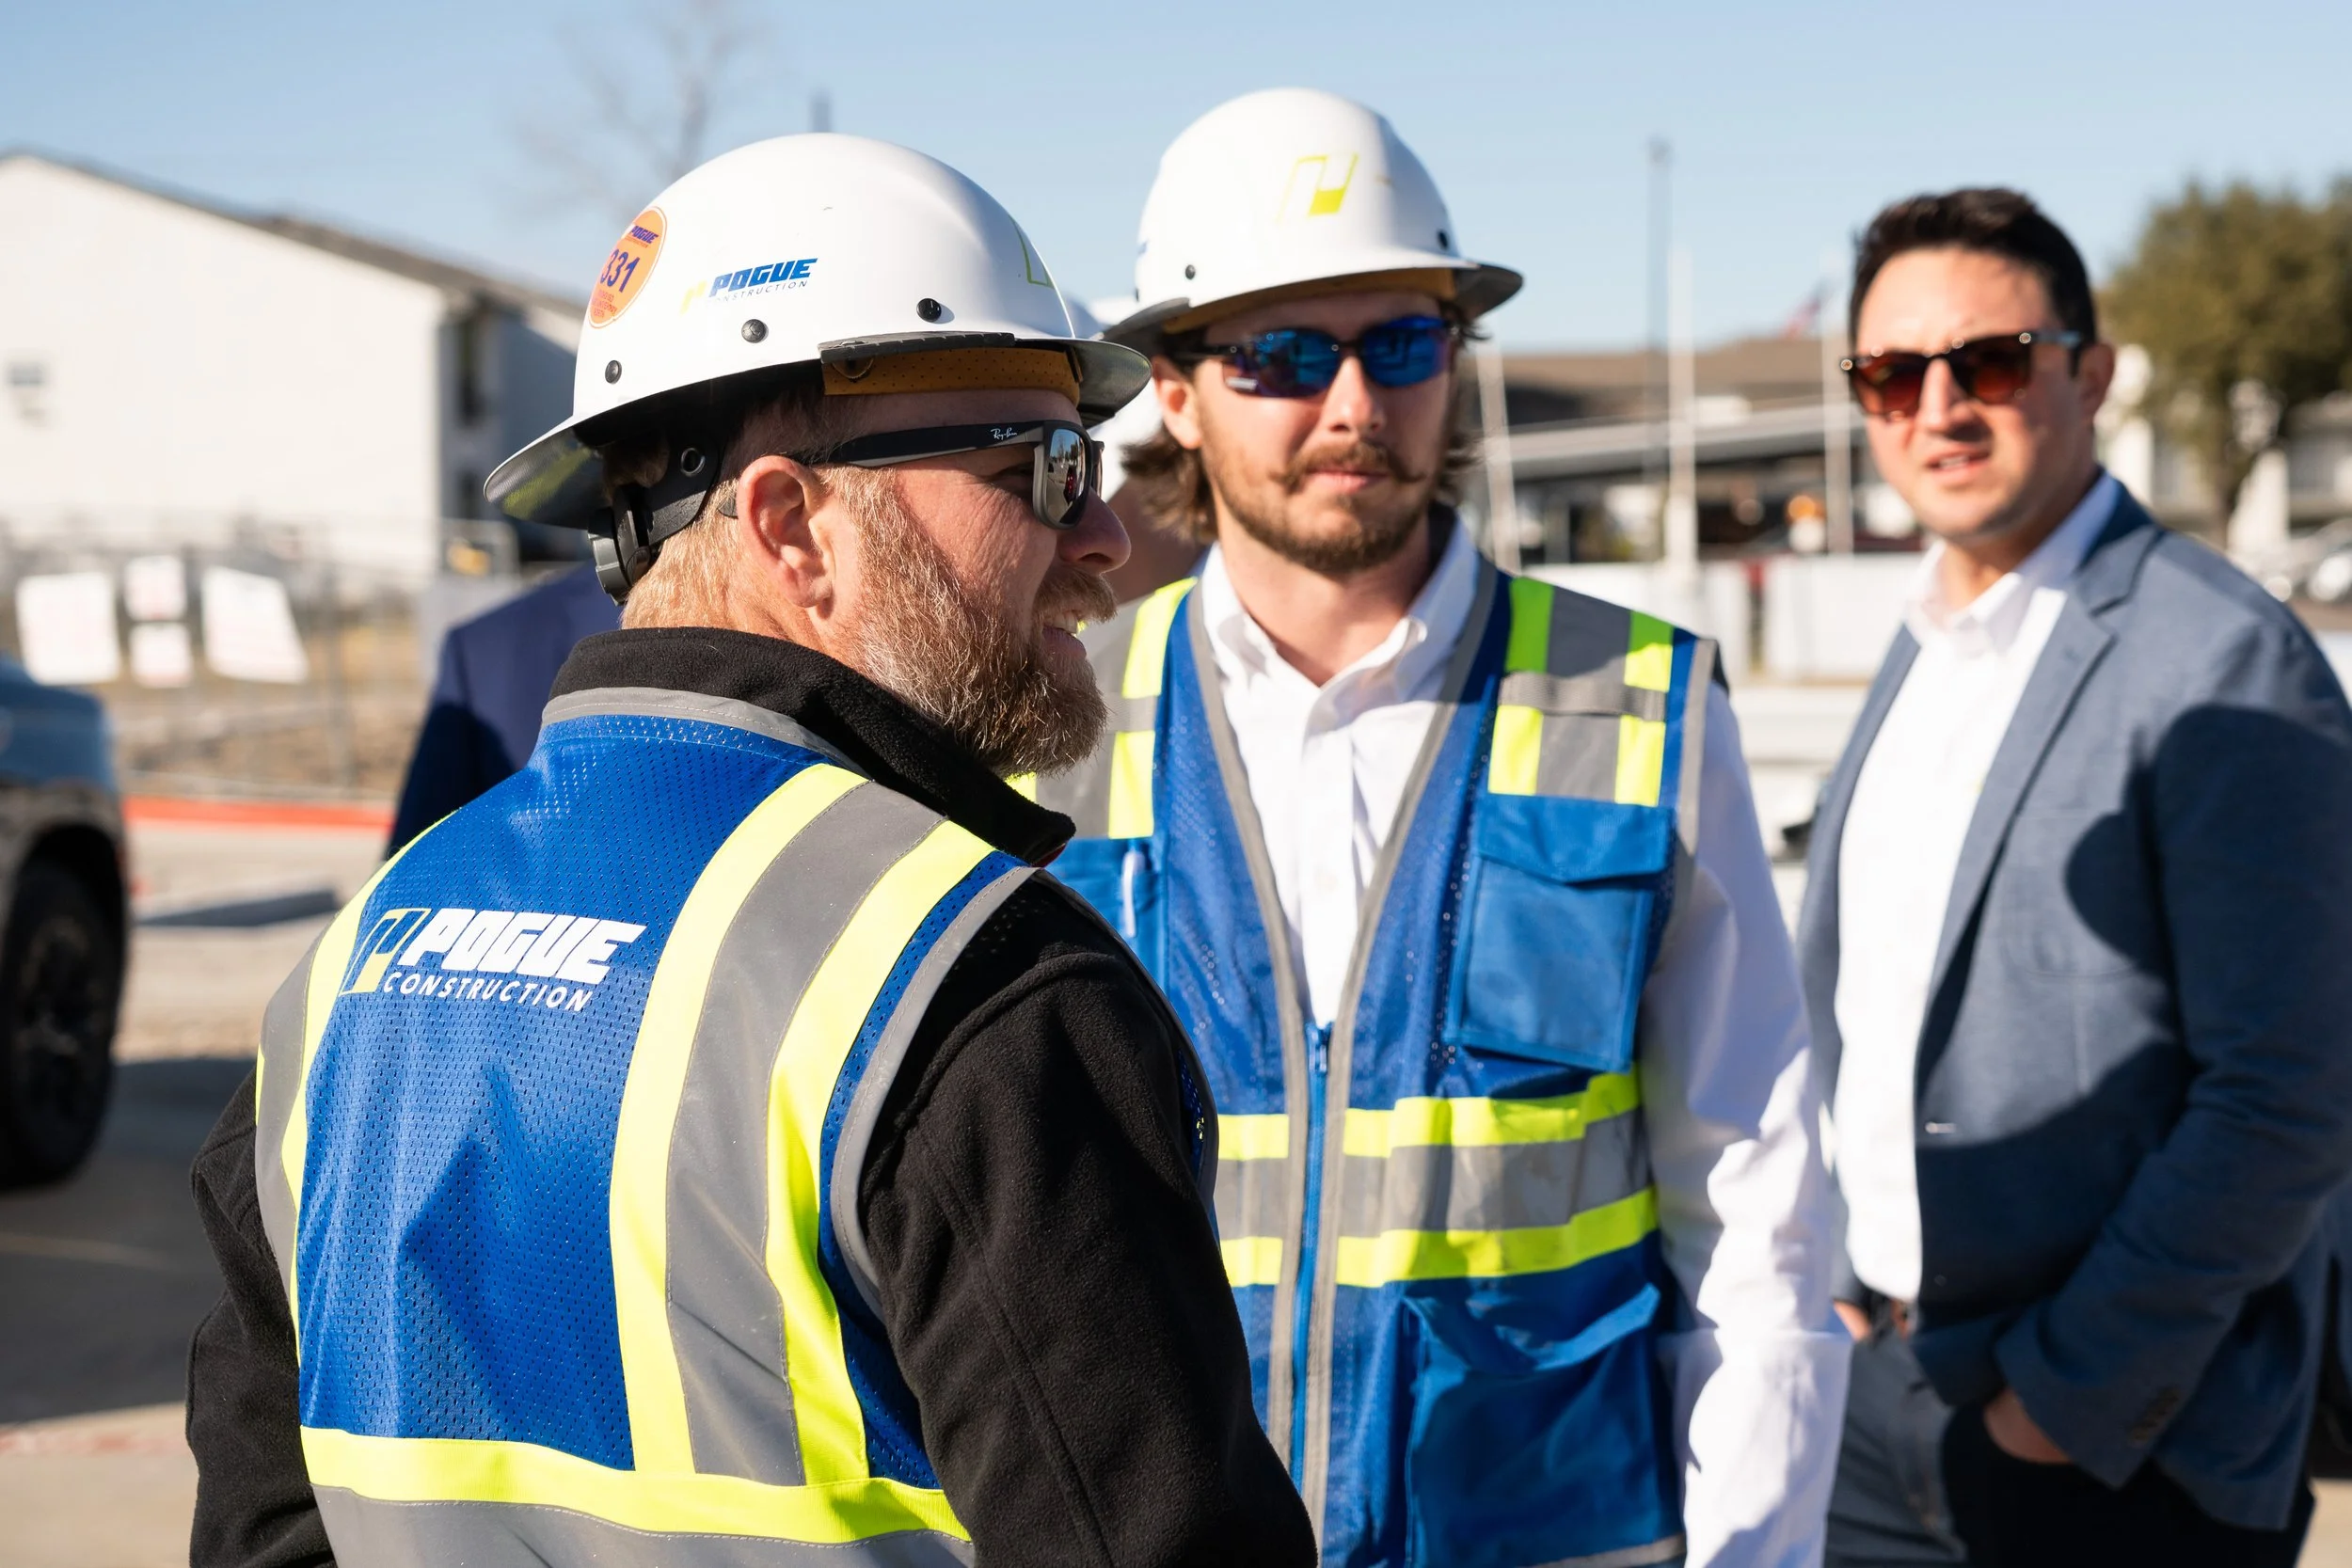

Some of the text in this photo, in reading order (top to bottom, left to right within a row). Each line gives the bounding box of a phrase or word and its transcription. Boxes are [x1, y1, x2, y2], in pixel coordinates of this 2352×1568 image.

[628, 226, 659, 244] POGUE
[708, 258, 818, 297] POGUE
[713, 280, 808, 302] NSTRUCTION
[991, 427, 1017, 440] Ray-Ban
[397, 908, 647, 985] POGUE
[383, 972, 593, 1012] CONSTRUCTION
